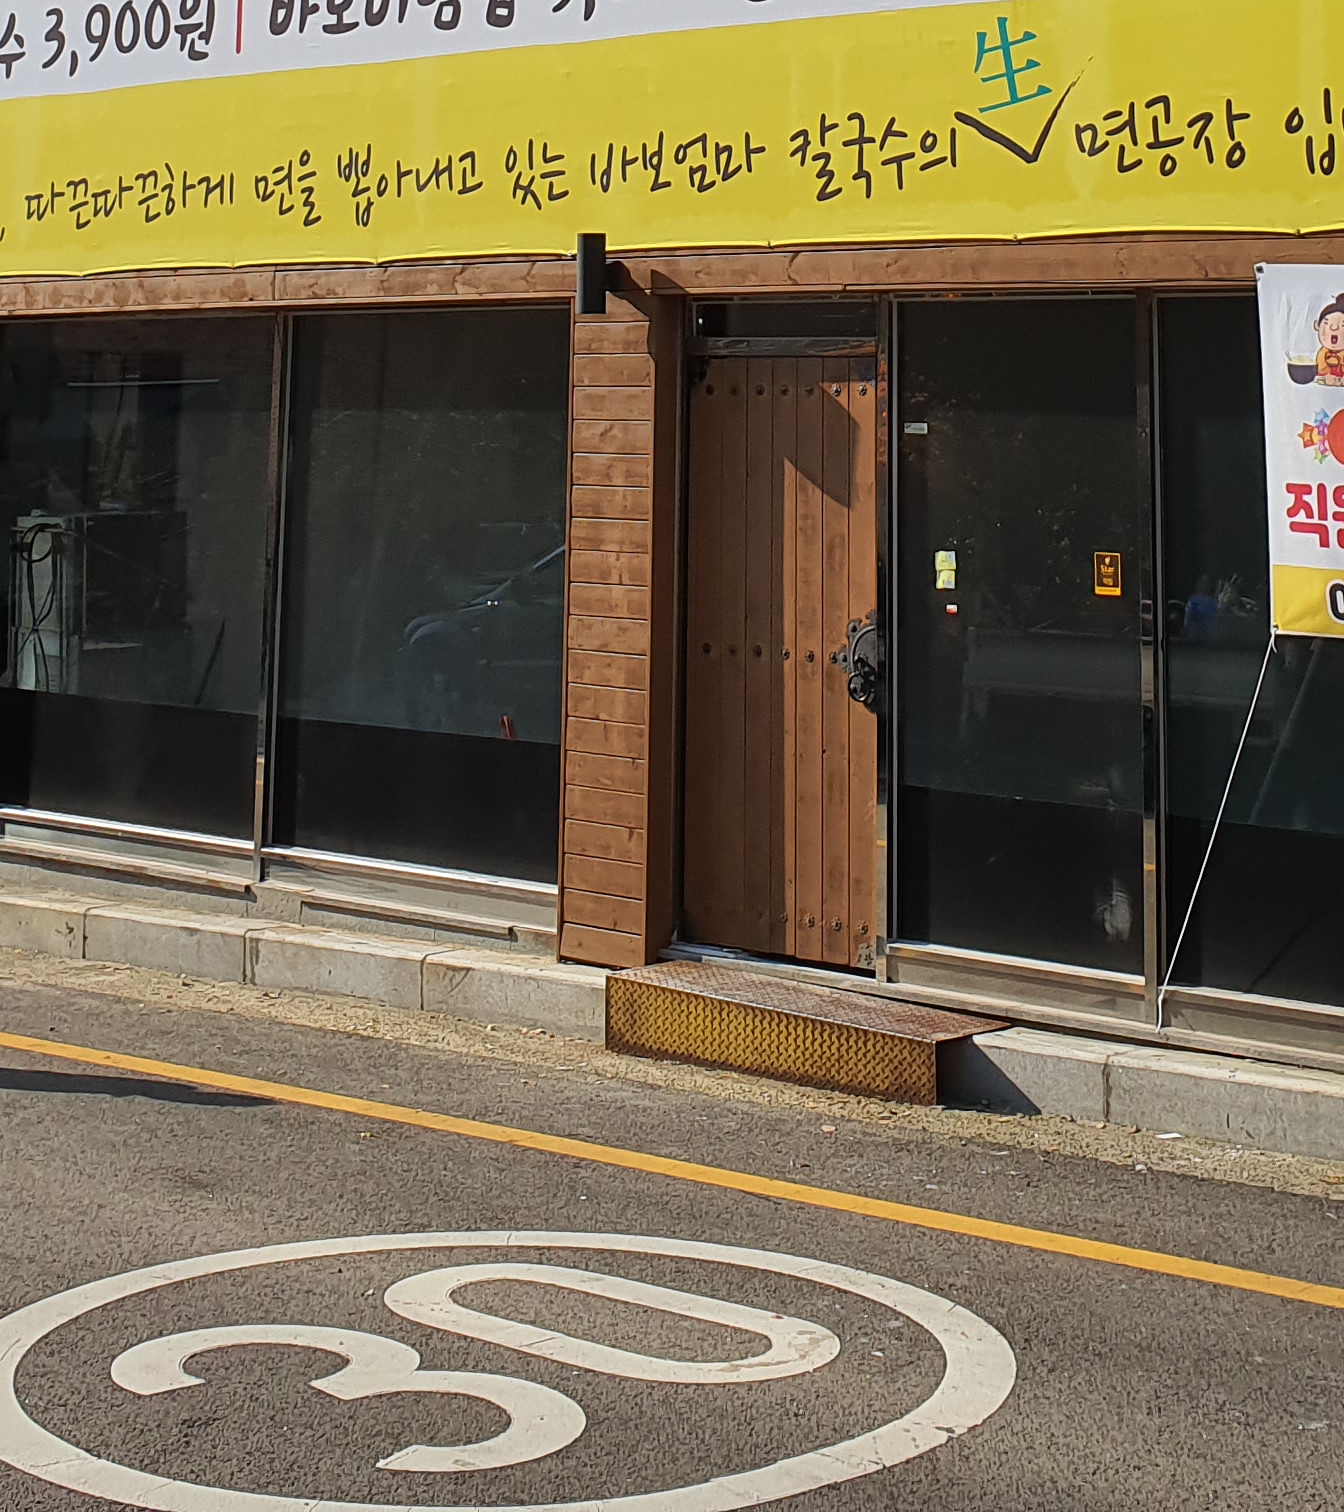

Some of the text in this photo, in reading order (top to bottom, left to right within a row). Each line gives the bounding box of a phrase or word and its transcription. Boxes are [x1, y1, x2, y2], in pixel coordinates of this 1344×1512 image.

[972, 14, 1054, 116] 生
[23, 161, 236, 231] 따끈따끈하게
[254, 147, 323, 227] 면을
[336, 142, 485, 227] 뽑아내고
[504, 137, 571, 211] 있는
[589, 130, 767, 194] 바보엄마
[787, 110, 959, 202] 칼국수의
[1075, 94, 1252, 177] 면공장
